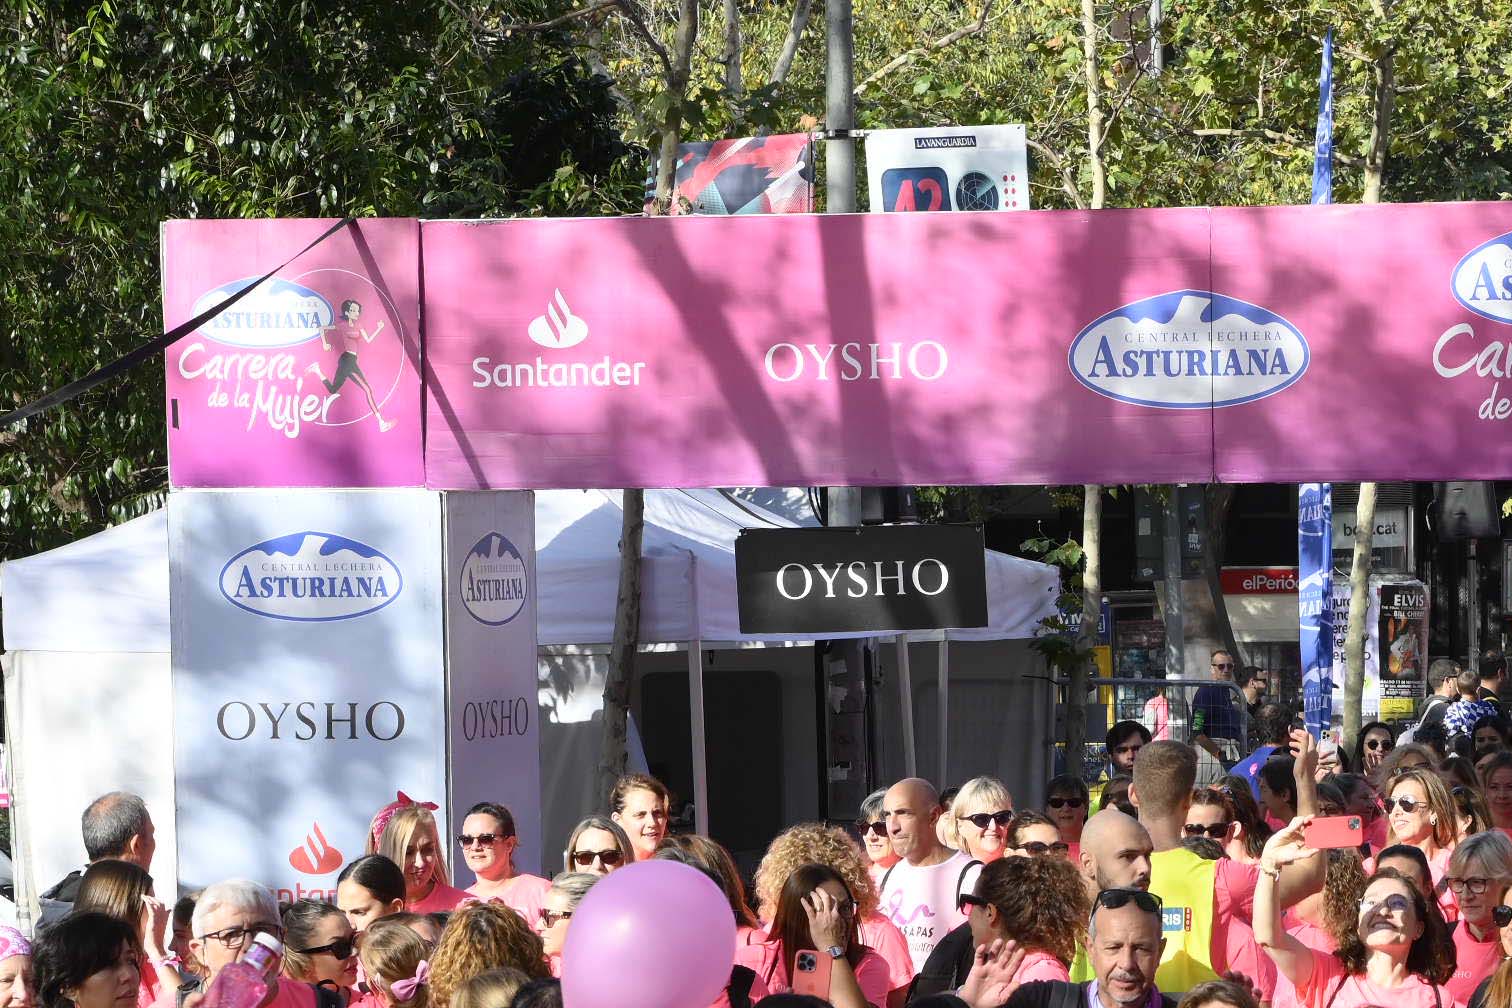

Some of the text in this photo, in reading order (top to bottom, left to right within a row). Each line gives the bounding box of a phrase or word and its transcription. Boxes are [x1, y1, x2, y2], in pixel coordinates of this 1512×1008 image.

[915, 137, 977, 149] LA VANGUARDIA
[1124, 328, 1283, 344] CENTRAL LECHERA
[179, 345, 296, 384] Carrera
[473, 357, 647, 389] Santander
[764, 340, 950, 383] OYSHO
[1087, 335, 1291, 379] ASTURIANA
[208, 377, 342, 440] de la Mujer
[1478, 382, 1512, 421] de
[233, 564, 390, 600] ASTURIANA
[261, 561, 384, 572] CENTRAL LECHERA
[465, 566, 524, 602] ASTURIANA
[775, 558, 949, 600] OYSHO
[1242, 575, 1300, 591] elPerió
[1393, 594, 1424, 607] ELVIS
[216, 700, 405, 741] OYSHO
[463, 696, 529, 742] OYSHO
